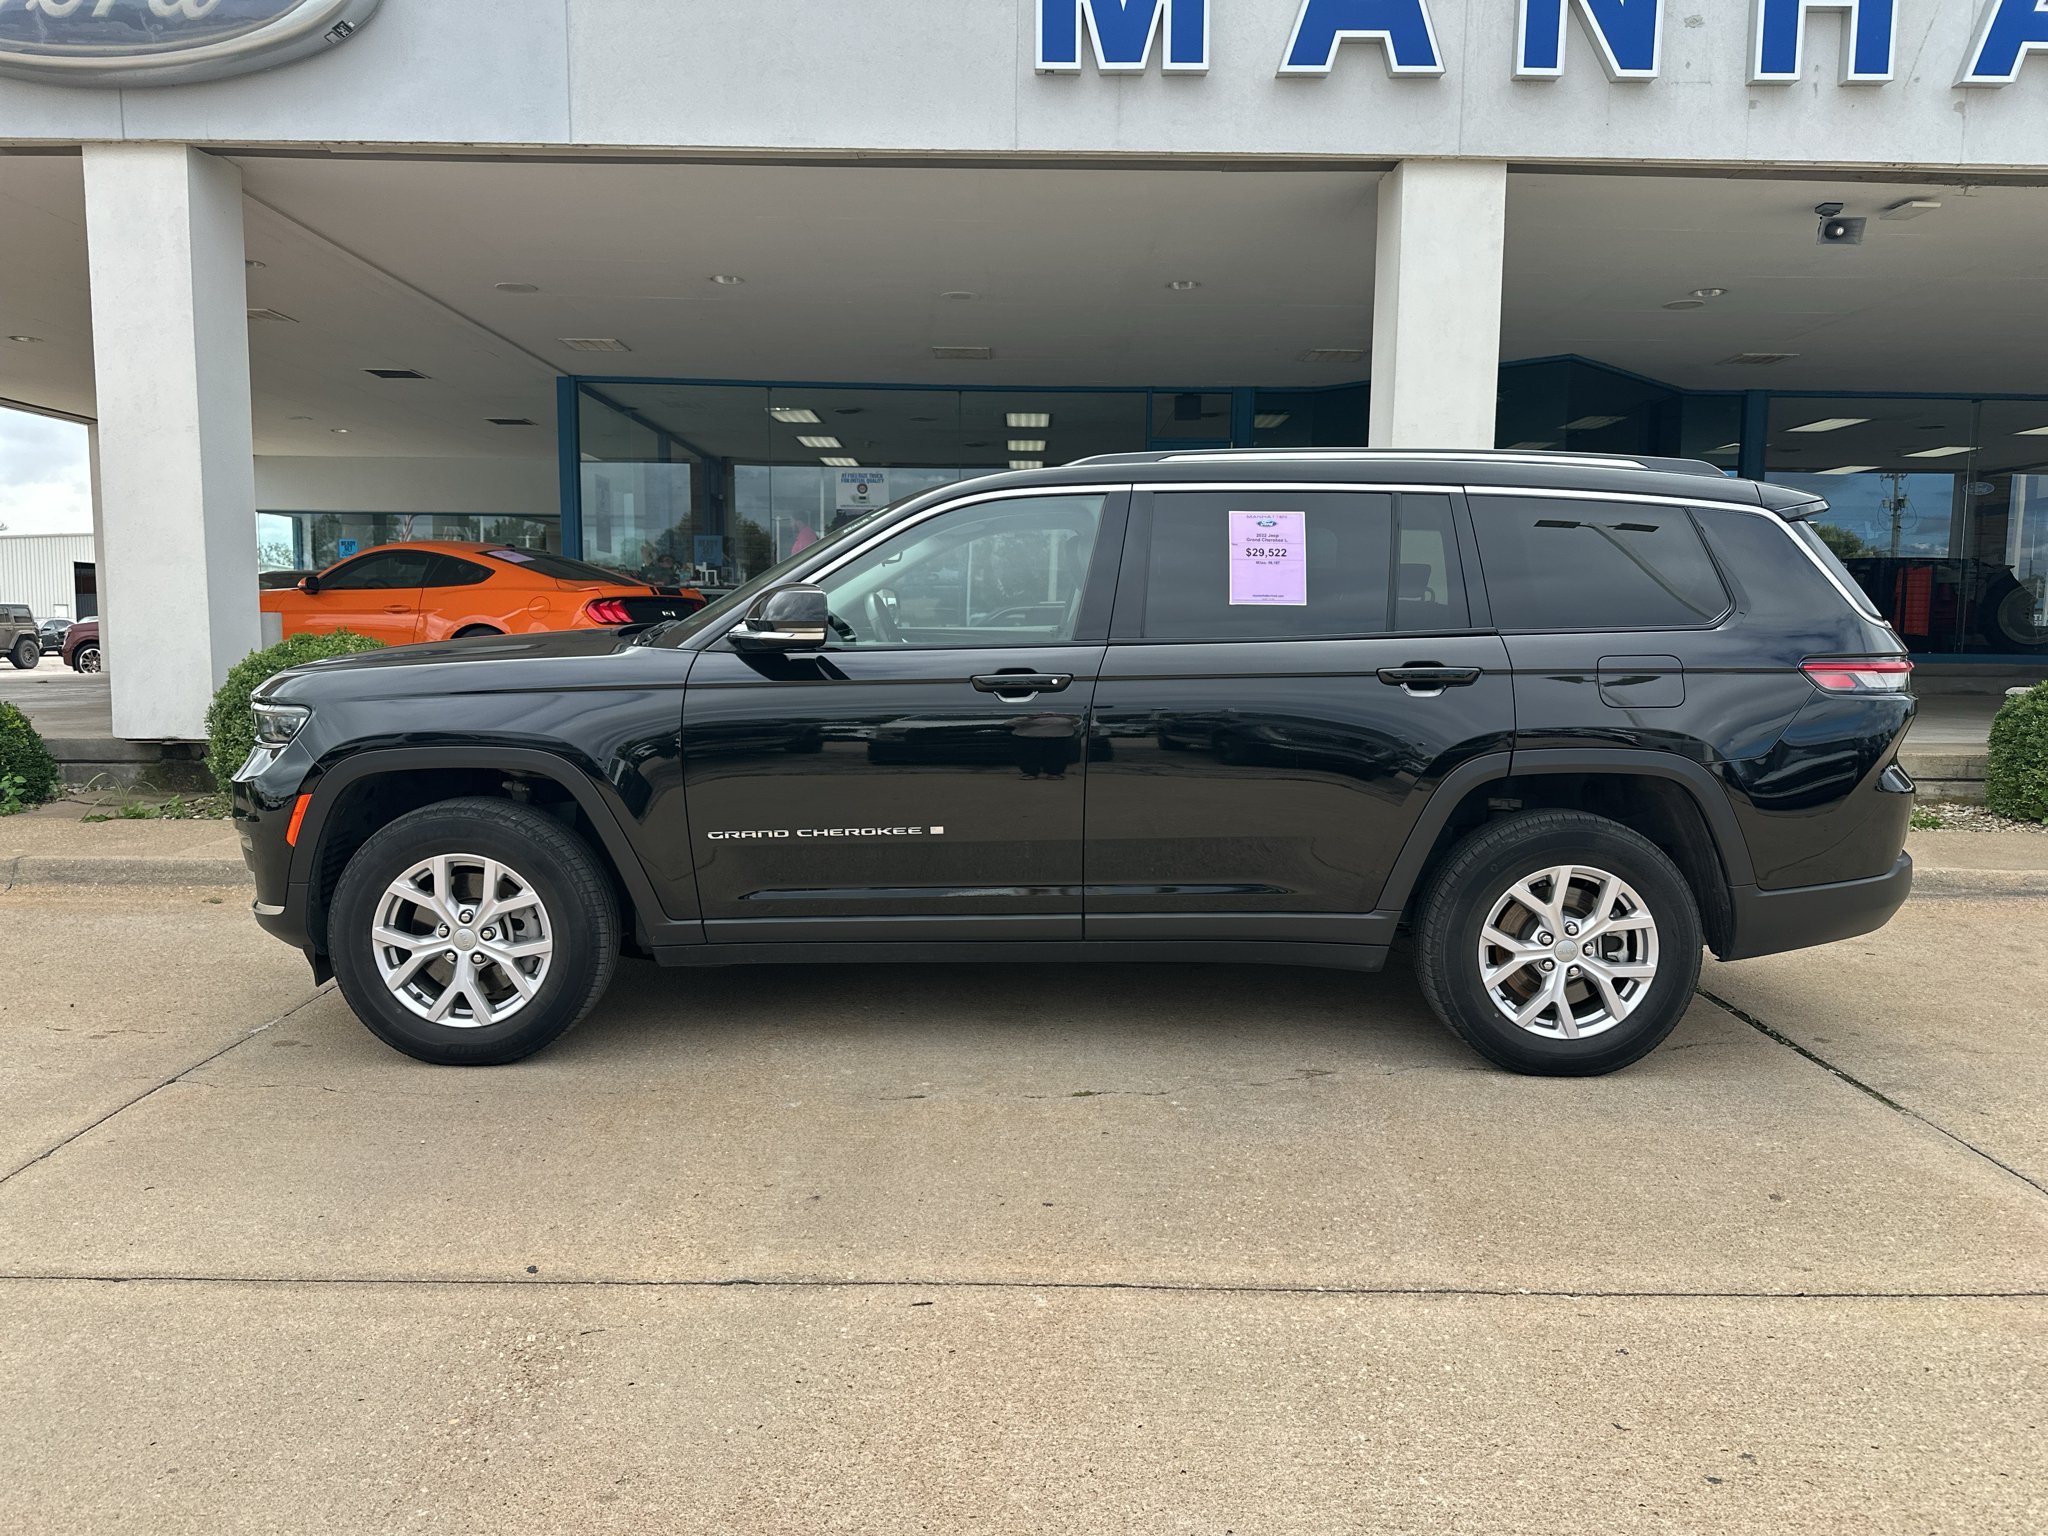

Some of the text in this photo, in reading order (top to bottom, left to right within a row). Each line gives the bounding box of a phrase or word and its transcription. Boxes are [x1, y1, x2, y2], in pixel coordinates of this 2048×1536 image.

[1245, 548, 1287, 558] $29,522
[707, 826, 923, 840] GRAND CHEROKEE
